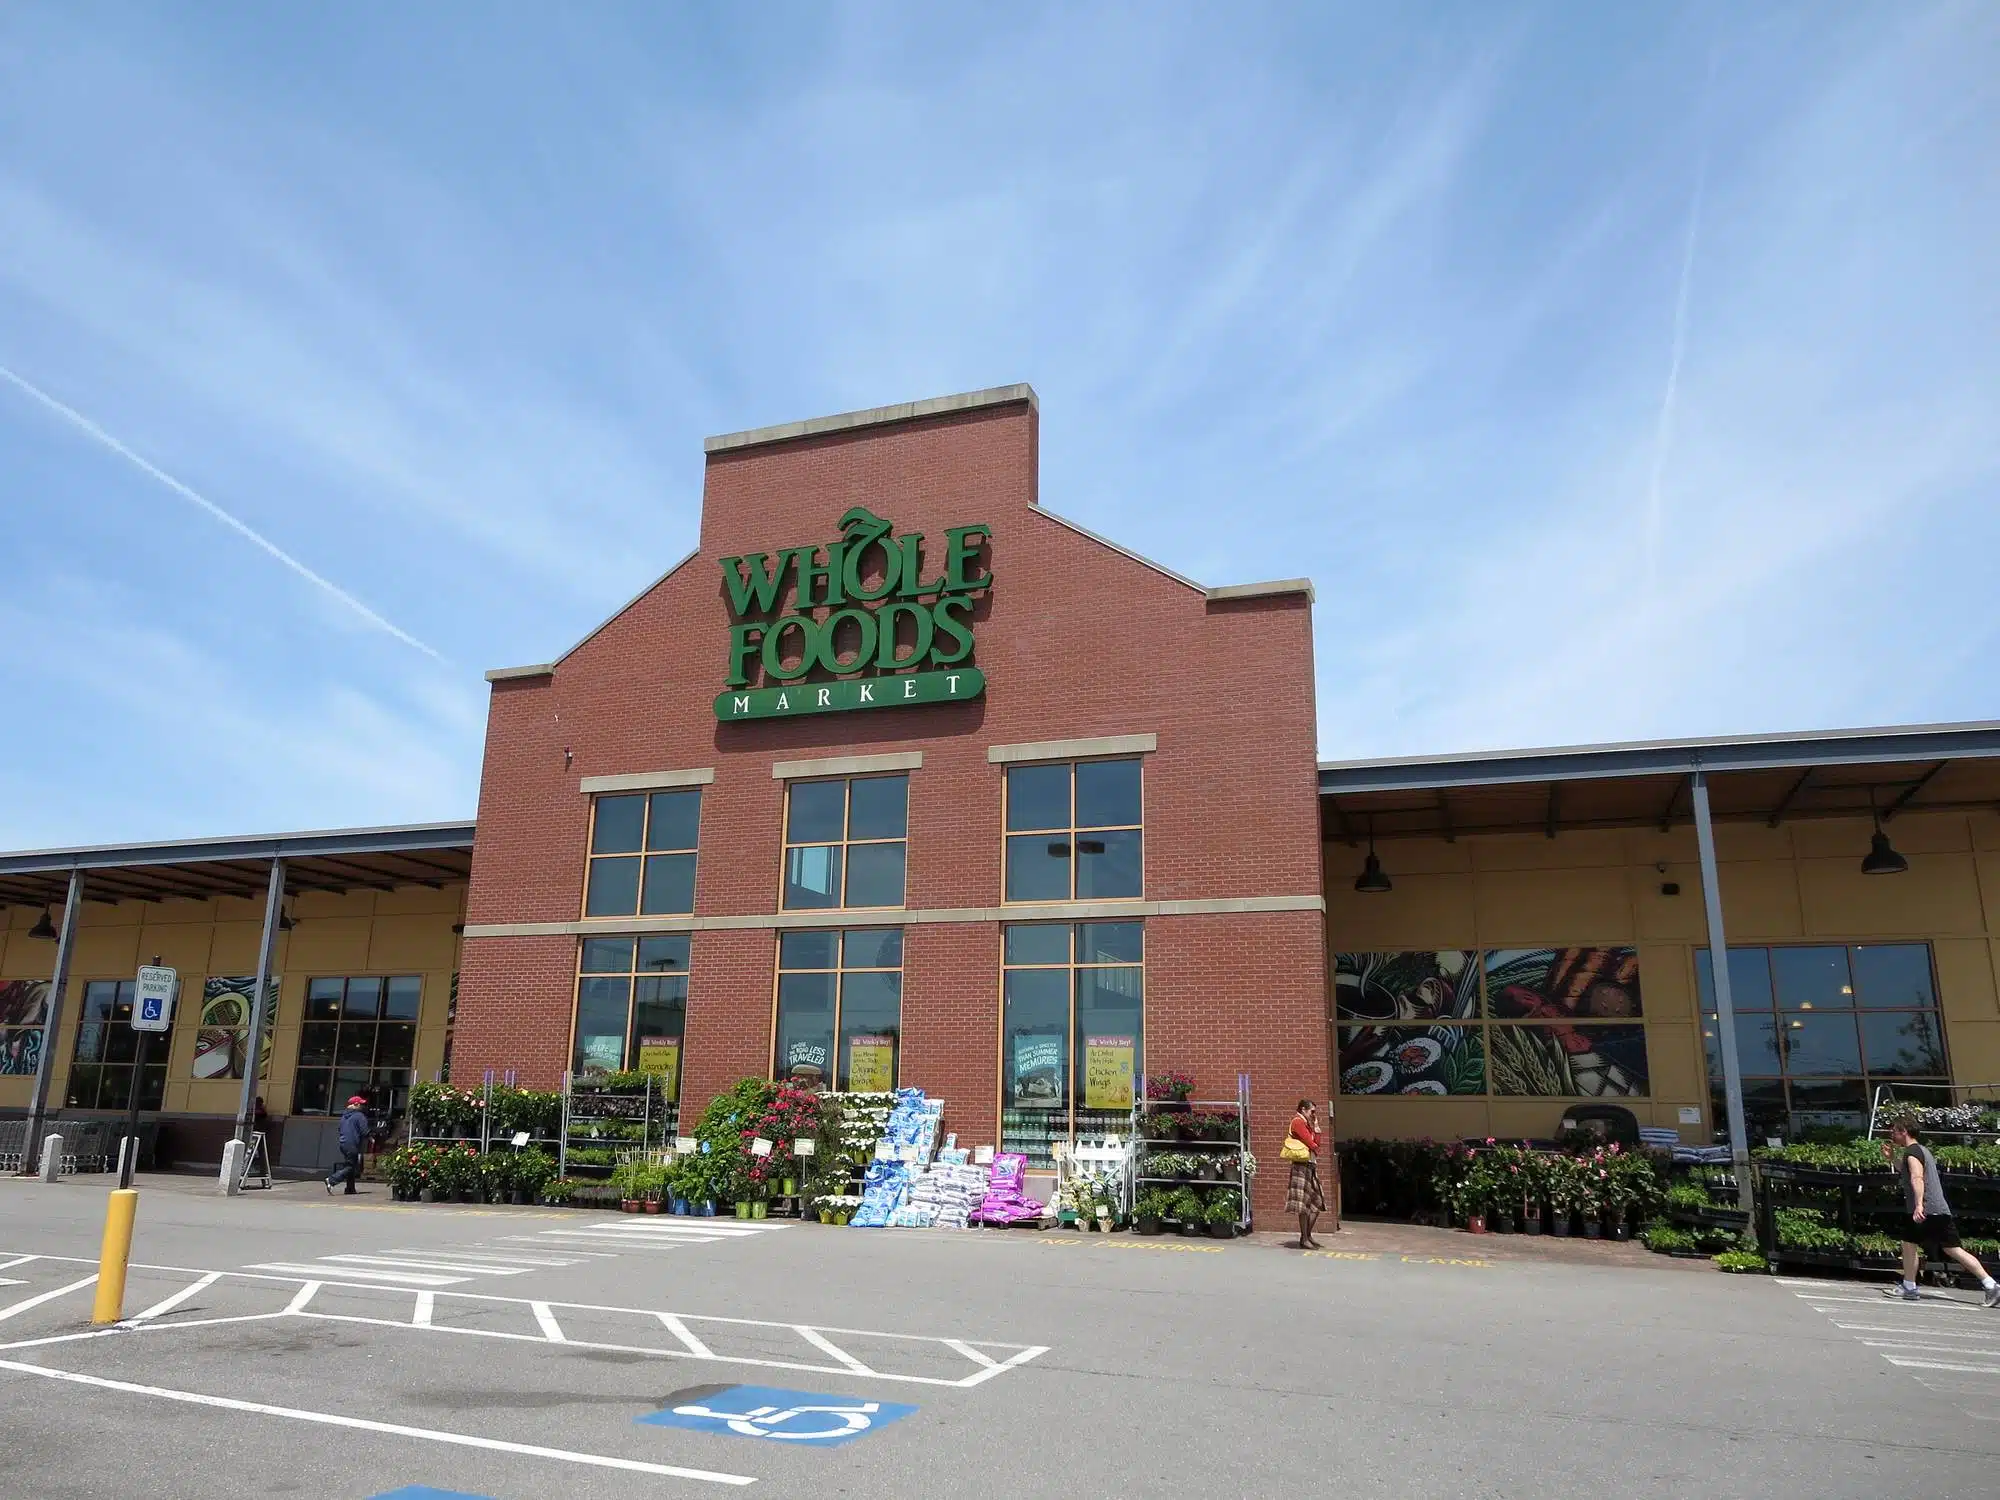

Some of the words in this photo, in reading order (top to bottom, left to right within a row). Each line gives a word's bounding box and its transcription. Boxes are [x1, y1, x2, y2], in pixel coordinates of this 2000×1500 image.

[719, 510, 992, 616] WHOLE
[724, 596, 976, 686] FOODS
[733, 675, 961, 714] MARKET
[141, 972, 173, 982] RESERVED
[142, 983, 168, 993] PARKING
[1099, 1039, 1118, 1047] Weekly
[809, 1045, 827, 1056] LESS
[1018, 1051, 1032, 1064] THAN
[1032, 1047, 1058, 1058] SUMMER
[788, 1053, 825, 1066] TRAVELED
[1019, 1055, 1058, 1074] MEMORIES
[1088, 1066, 1117, 1077] Chicken
[1089, 1077, 1112, 1090] Wings
[1036, 1238, 1083, 1247] NO
[1093, 1239, 1226, 1253] PARKING
[1303, 1251, 1381, 1261] FIRE
[1400, 1255, 1497, 1268] LANE
